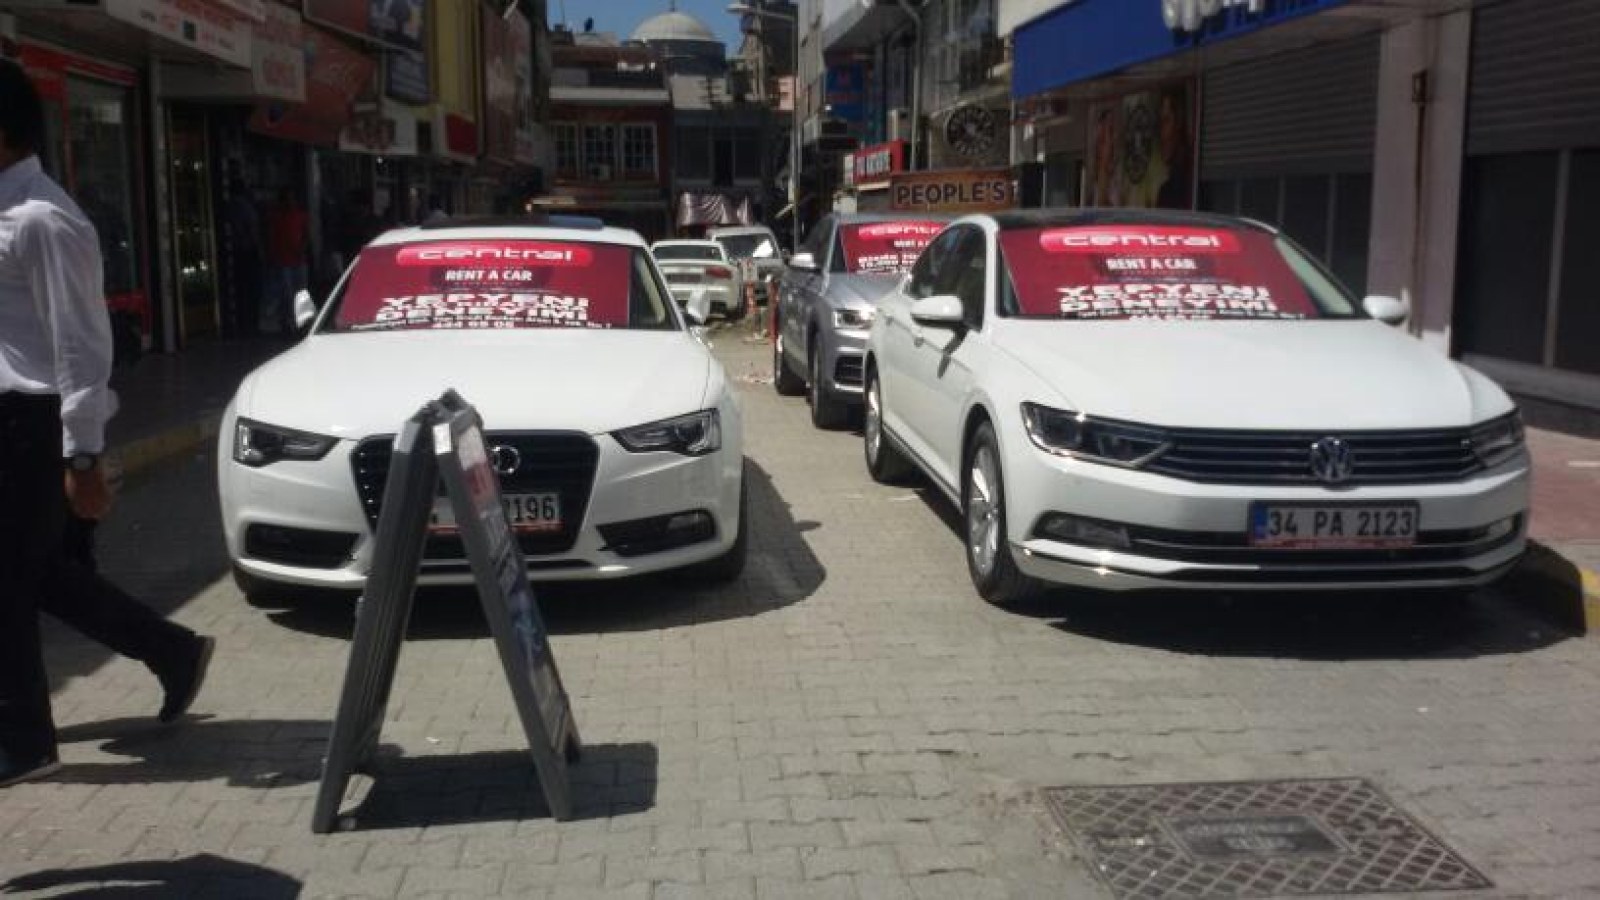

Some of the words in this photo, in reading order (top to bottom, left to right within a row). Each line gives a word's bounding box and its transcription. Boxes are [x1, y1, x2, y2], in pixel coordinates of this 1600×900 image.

[897, 180, 1005, 205] PEOPLE'S
[1063, 232, 1221, 248] central
[417, 246, 573, 262] central
[1105, 258, 1146, 270] RENT
[1150, 258, 1163, 270] A
[1164, 258, 1197, 270] CAR
[445, 269, 485, 281] RENT
[488, 269, 499, 281] A
[502, 269, 532, 281] CAR
[1269, 510, 1298, 537] 34
[1314, 510, 1344, 537] PA
[1356, 510, 1413, 537] 2123
